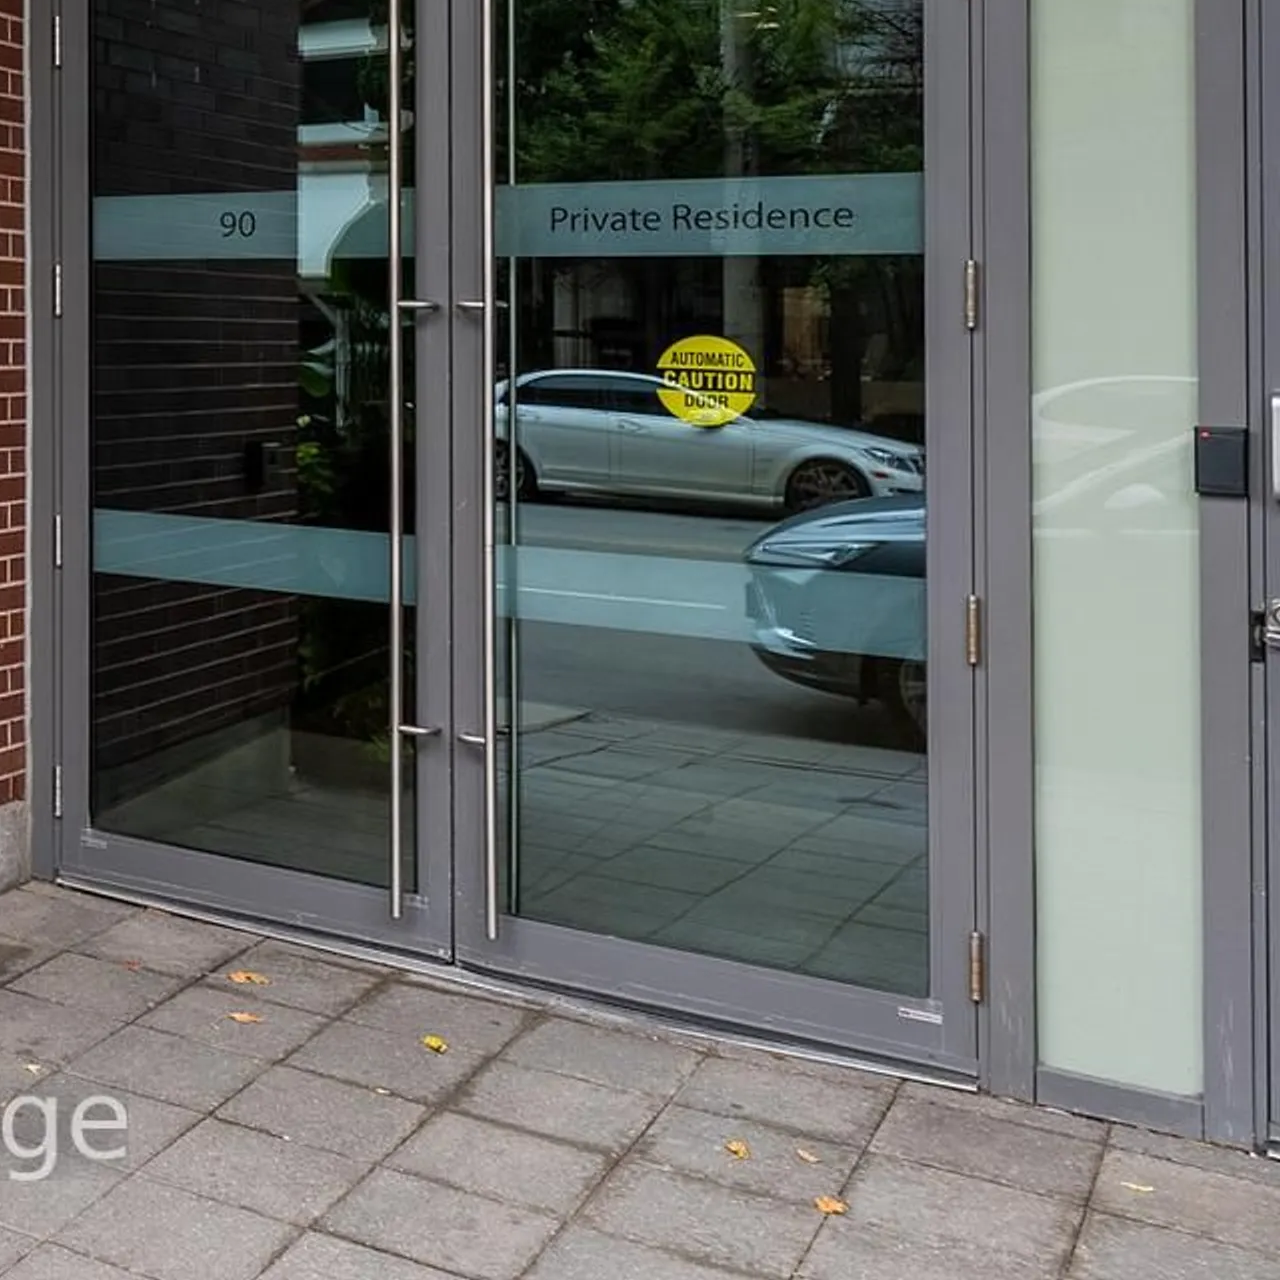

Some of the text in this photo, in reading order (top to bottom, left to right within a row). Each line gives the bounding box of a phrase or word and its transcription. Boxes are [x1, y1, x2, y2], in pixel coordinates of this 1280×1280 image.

[219, 211, 256, 239] 90
[550, 201, 854, 232] Private Residence
[670, 351, 745, 368] AUTOMATIC
[663, 370, 754, 391] CAUTION
[684, 393, 729, 409] DOOR
